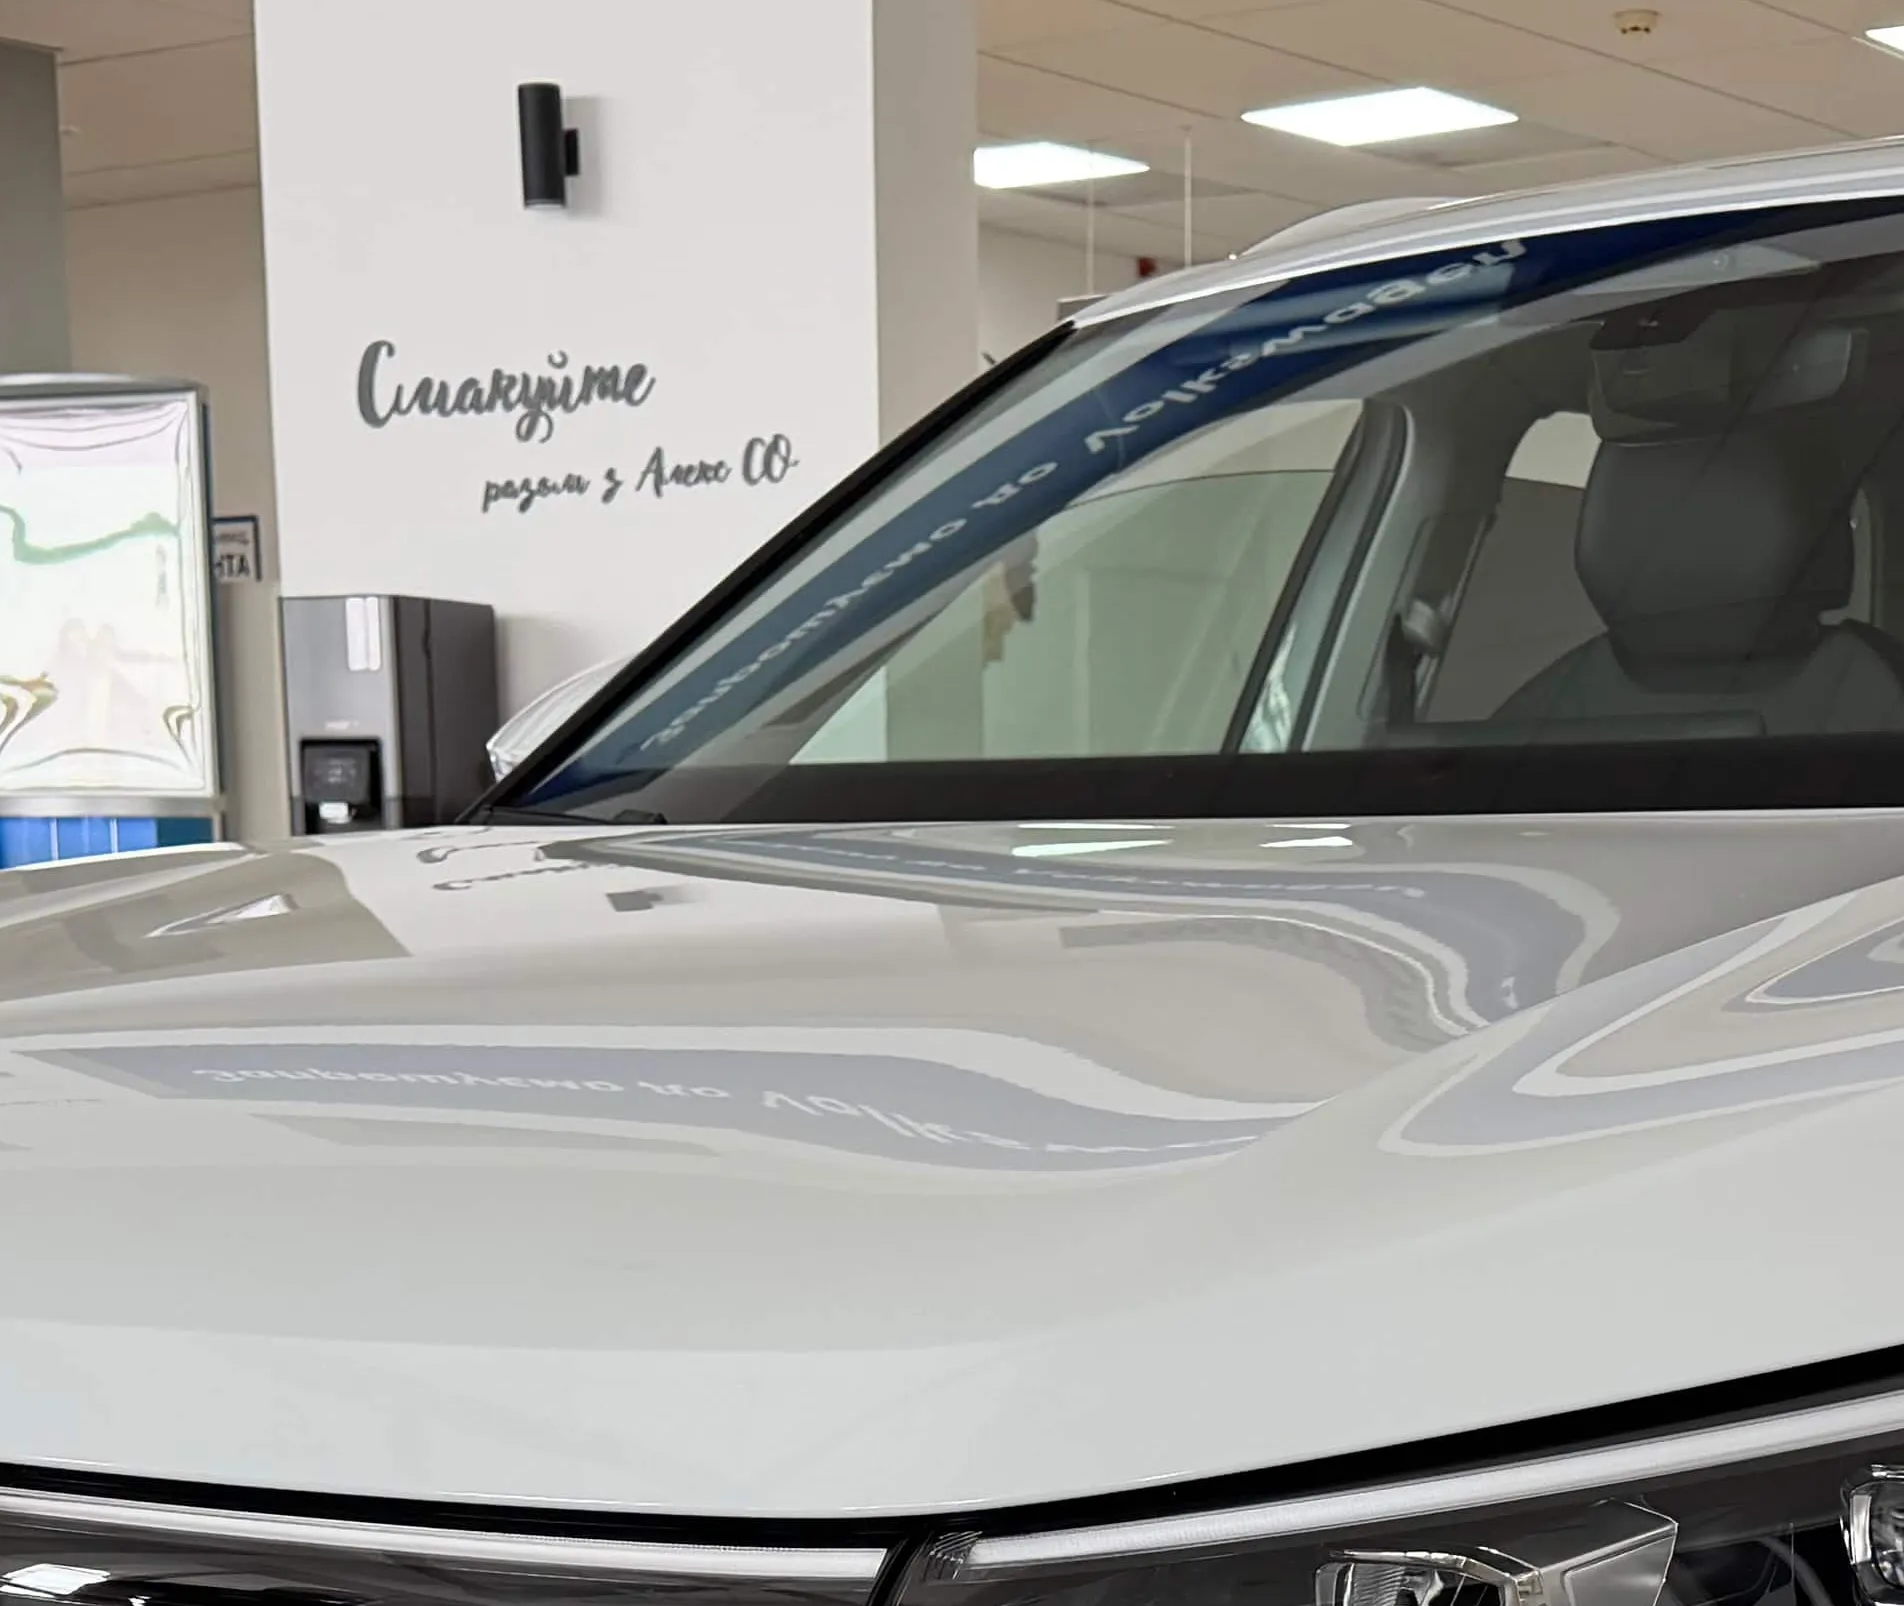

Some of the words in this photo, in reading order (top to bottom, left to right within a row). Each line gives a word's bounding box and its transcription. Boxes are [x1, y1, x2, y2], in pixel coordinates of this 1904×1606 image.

[357, 339, 656, 443] Смакуйте
[482, 472, 590, 513] разом
[601, 467, 623, 503] з
[635, 446, 731, 498] Алекс
[741, 433, 799, 486] СО
